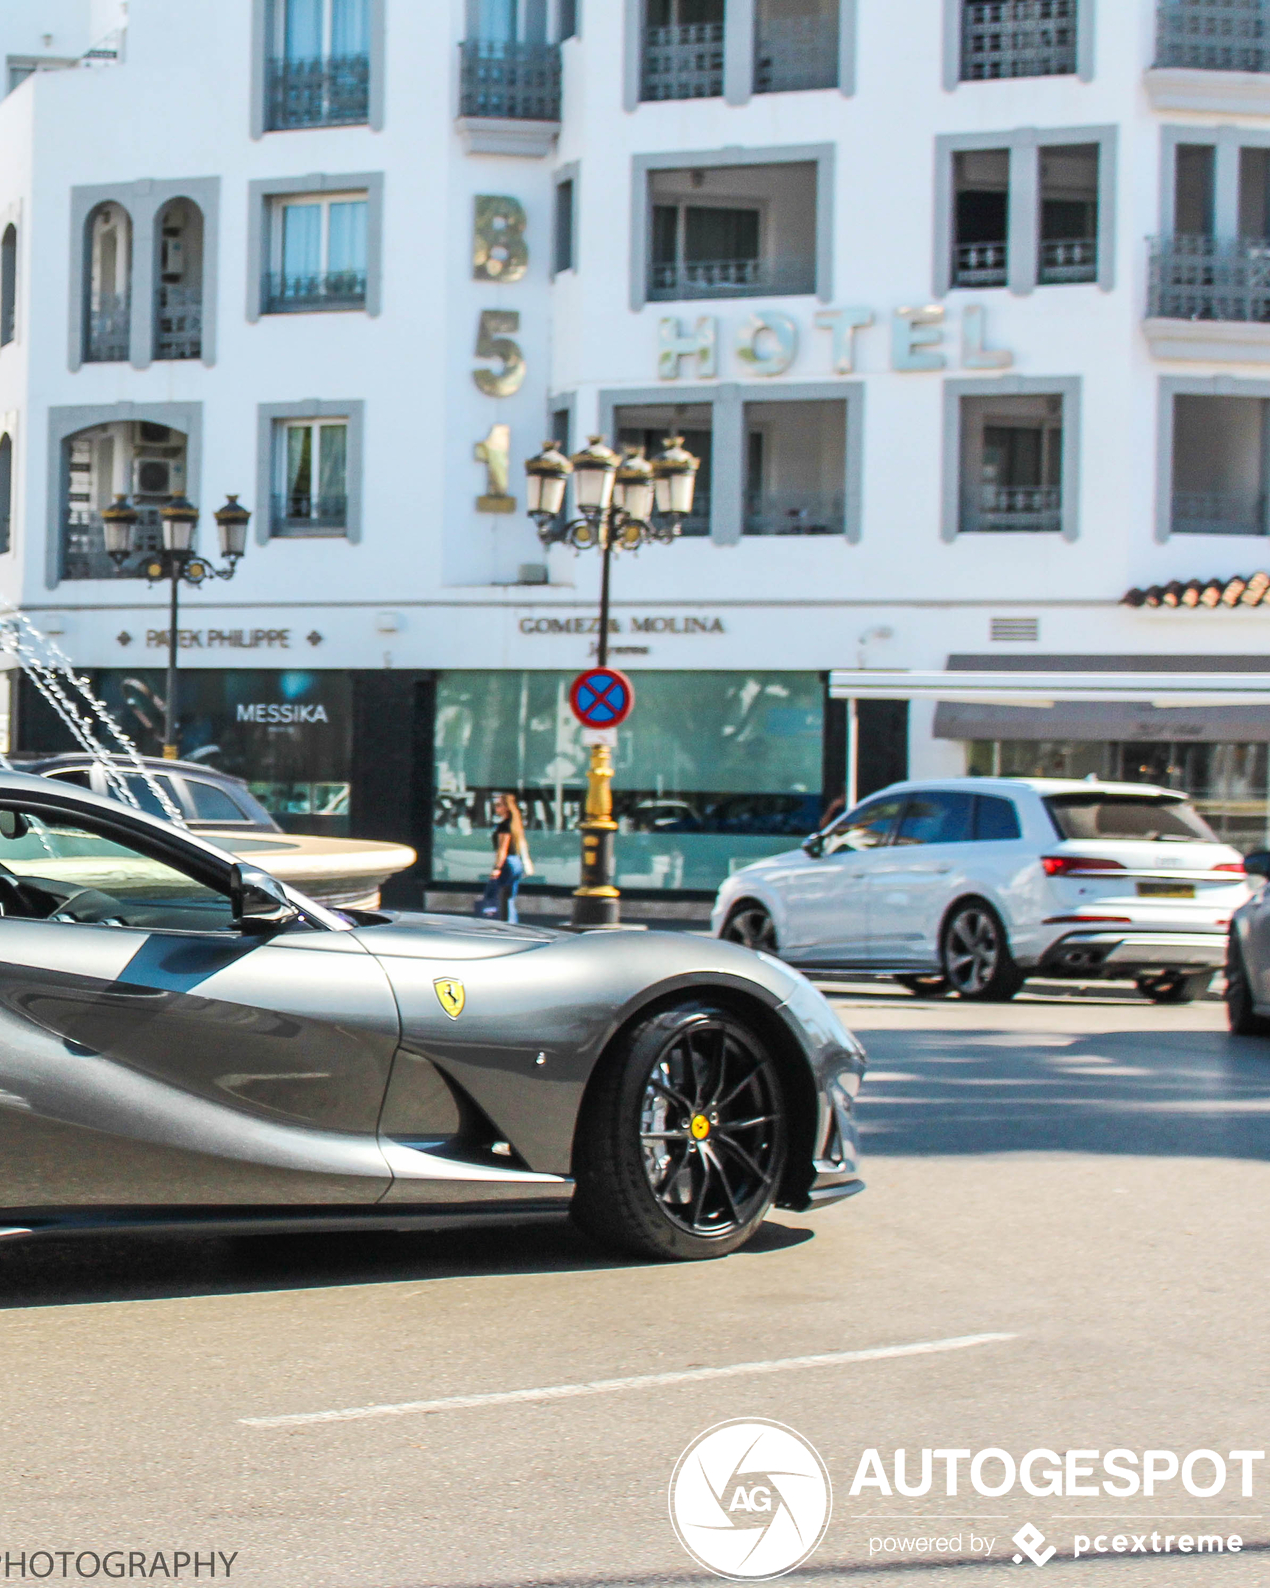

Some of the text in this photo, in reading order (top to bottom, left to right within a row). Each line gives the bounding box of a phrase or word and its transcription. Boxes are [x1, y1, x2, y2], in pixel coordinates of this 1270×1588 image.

[658, 304, 1014, 380] HOTEL
[630, 616, 725, 634] MOLINA
[207, 628, 292, 648] PHILIPPE
[236, 703, 329, 724] MESSIKA
